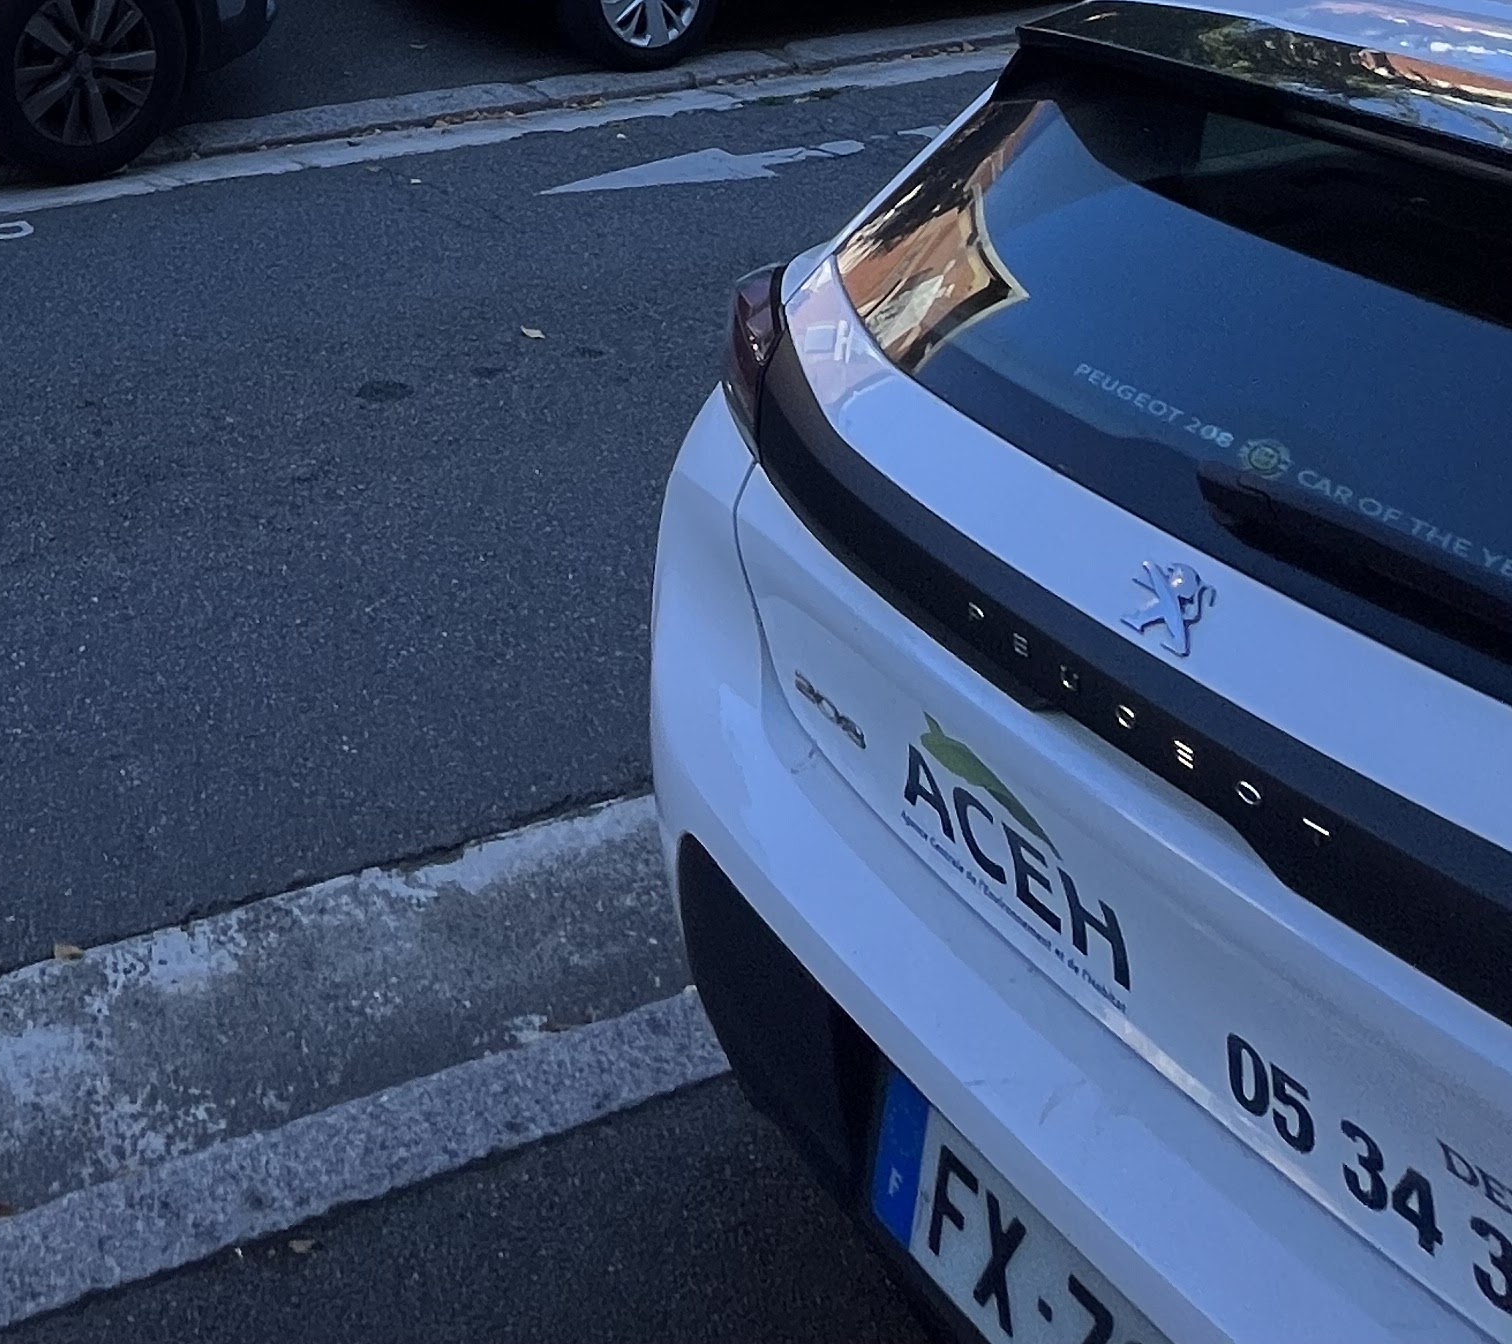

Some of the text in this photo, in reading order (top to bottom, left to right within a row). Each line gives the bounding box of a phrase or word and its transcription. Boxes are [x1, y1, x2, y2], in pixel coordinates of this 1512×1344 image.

[1073, 362, 1235, 449] PEUGEOT 208
[1297, 470, 1354, 506] CAR
[1358, 497, 1403, 523] OF
[1410, 516, 1473, 559] THE
[794, 669, 867, 750] 208
[967, 601, 1331, 845] PEUGEOT
[903, 743, 1132, 993] ACEH
[888, 1166, 904, 1198] F
[1226, 1032, 1316, 1154] 05
[1340, 1118, 1444, 1258] 34
